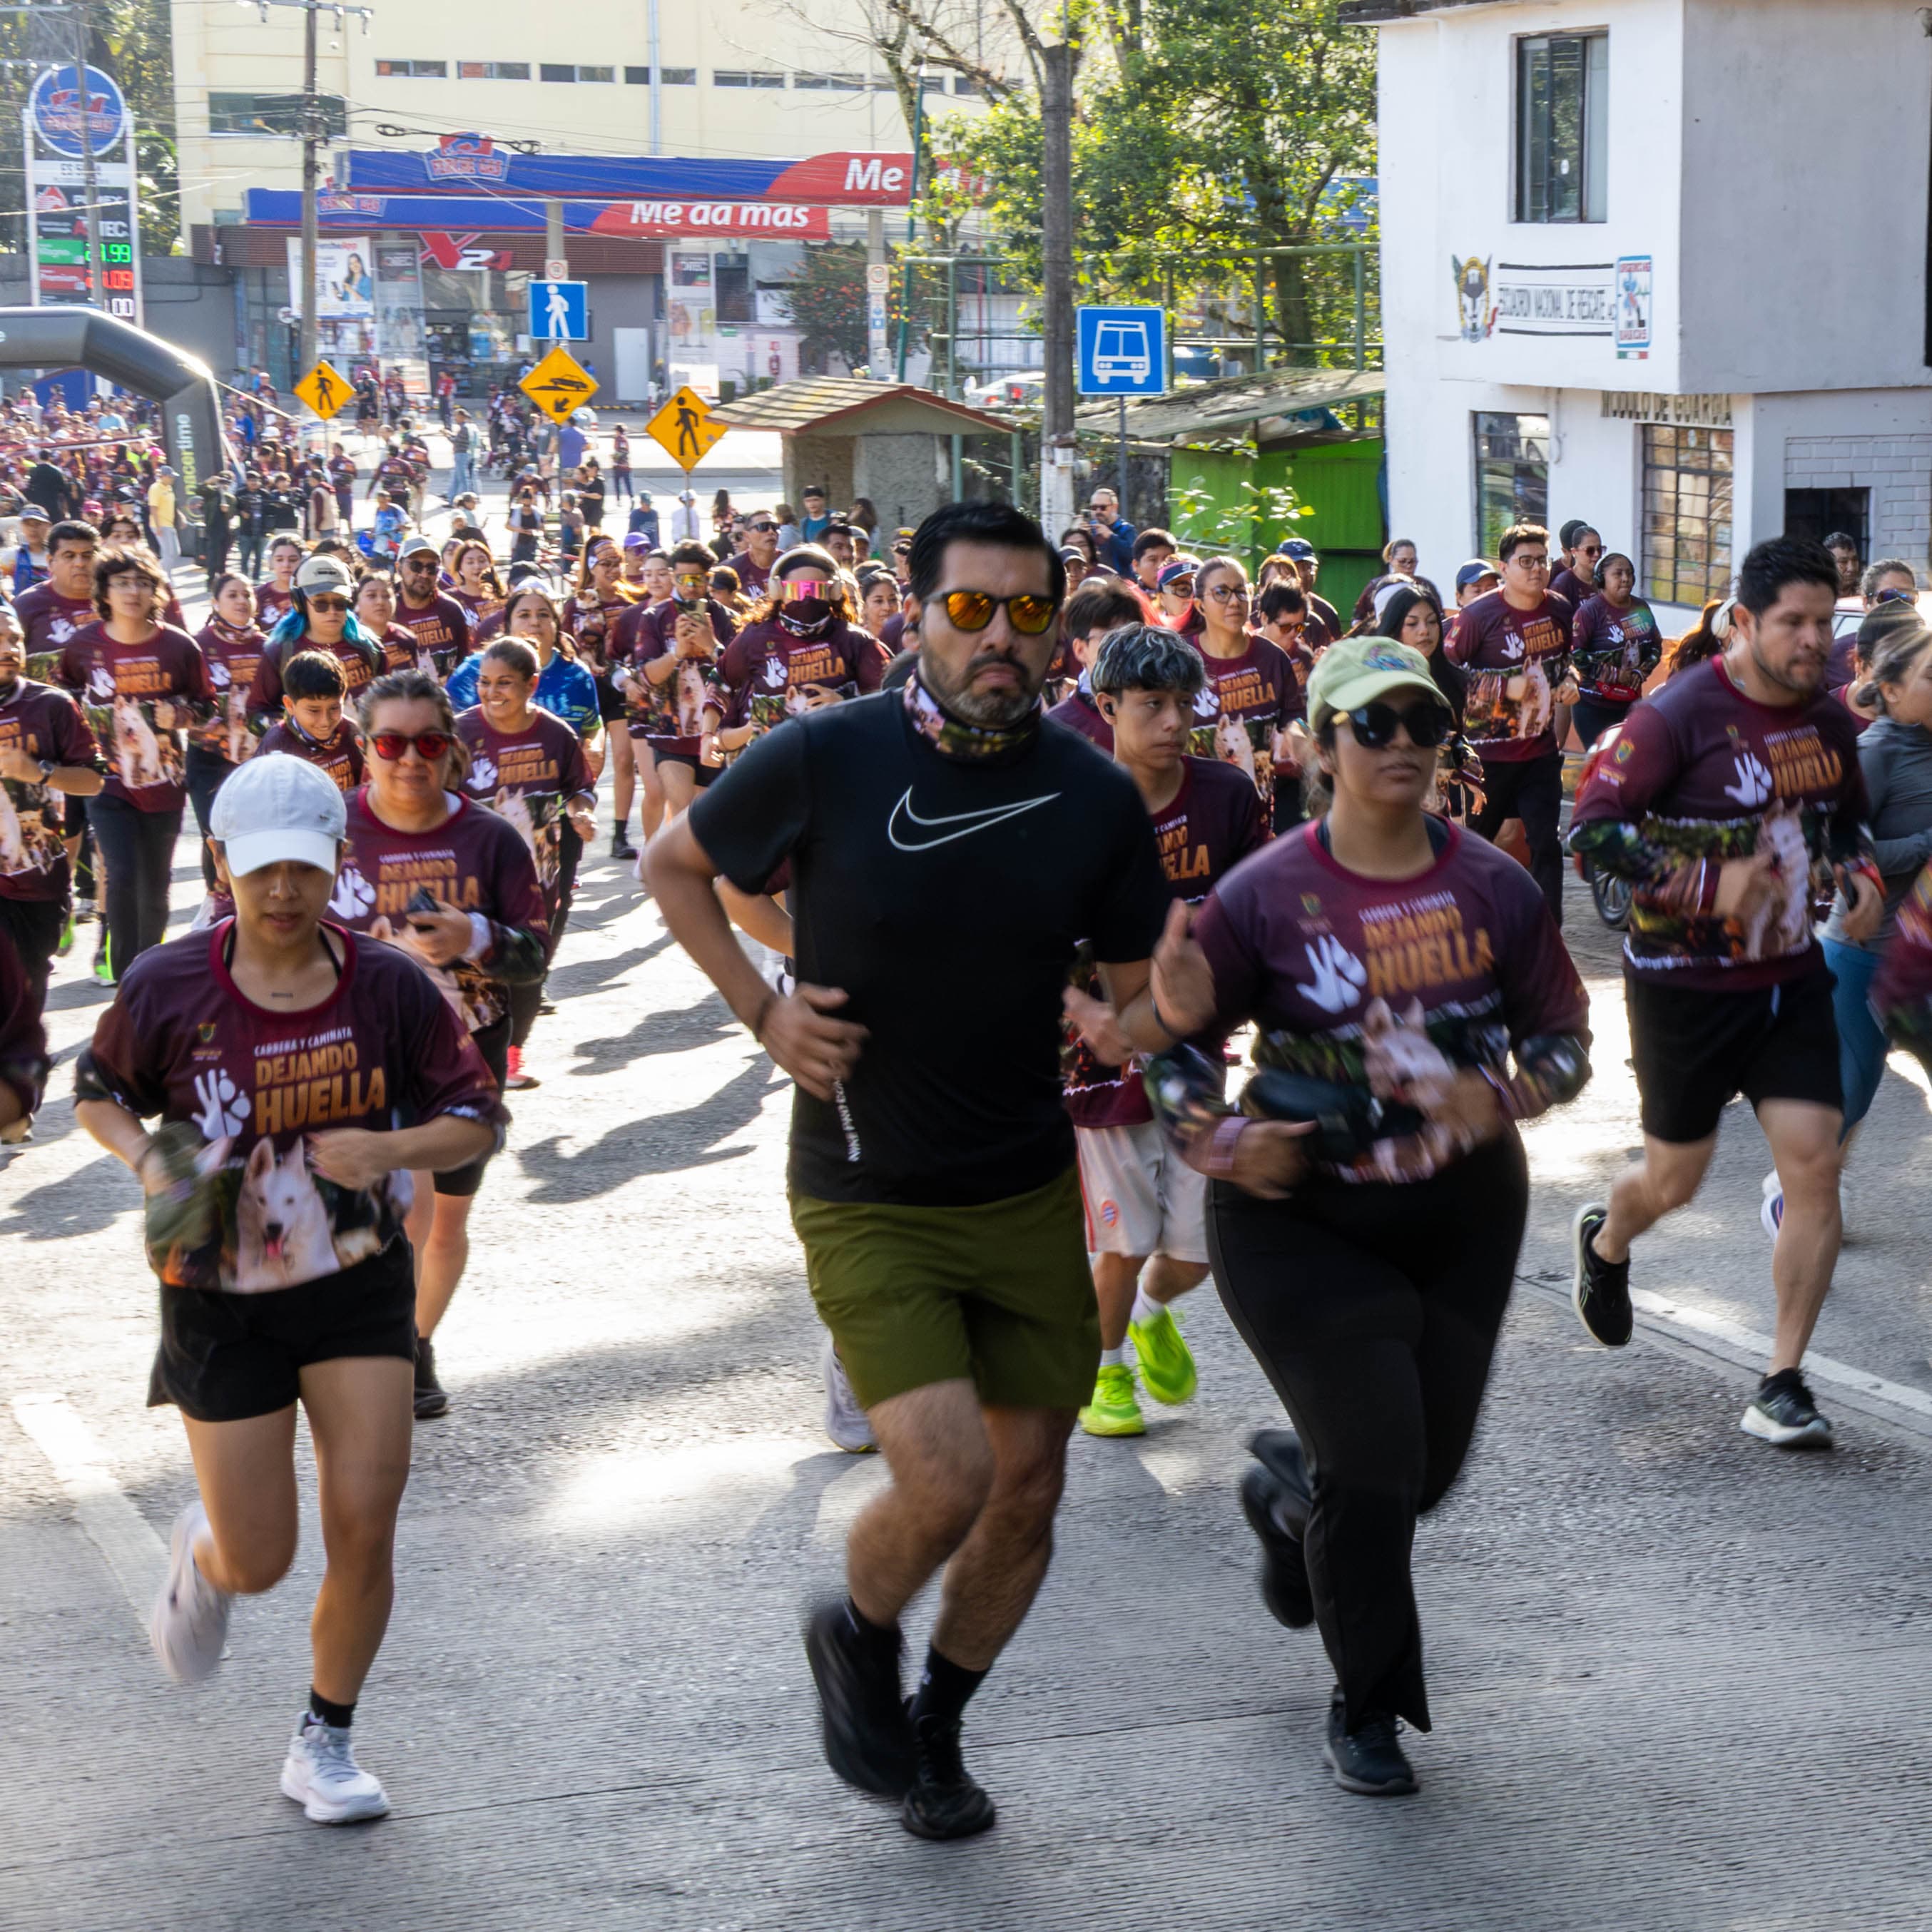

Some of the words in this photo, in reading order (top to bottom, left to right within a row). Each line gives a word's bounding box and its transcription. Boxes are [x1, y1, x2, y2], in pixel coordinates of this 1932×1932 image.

[845, 158, 904, 191] Me
[788, 648, 832, 666] DEJANDO
[1525, 628, 1565, 655] HUELLA
[788, 656, 846, 686] HUELLA
[1219, 672, 1261, 694] DEJANDO
[1219, 681, 1277, 713] HUELLA
[1366, 927, 1495, 997] HUELLA
[254, 1039, 298, 1057] CARRERA
[300, 1037, 306, 1051] Y
[307, 1026, 353, 1048] CAMINATA
[255, 1041, 358, 1088] DEJANDO
[255, 1066, 387, 1136] HUELLA
